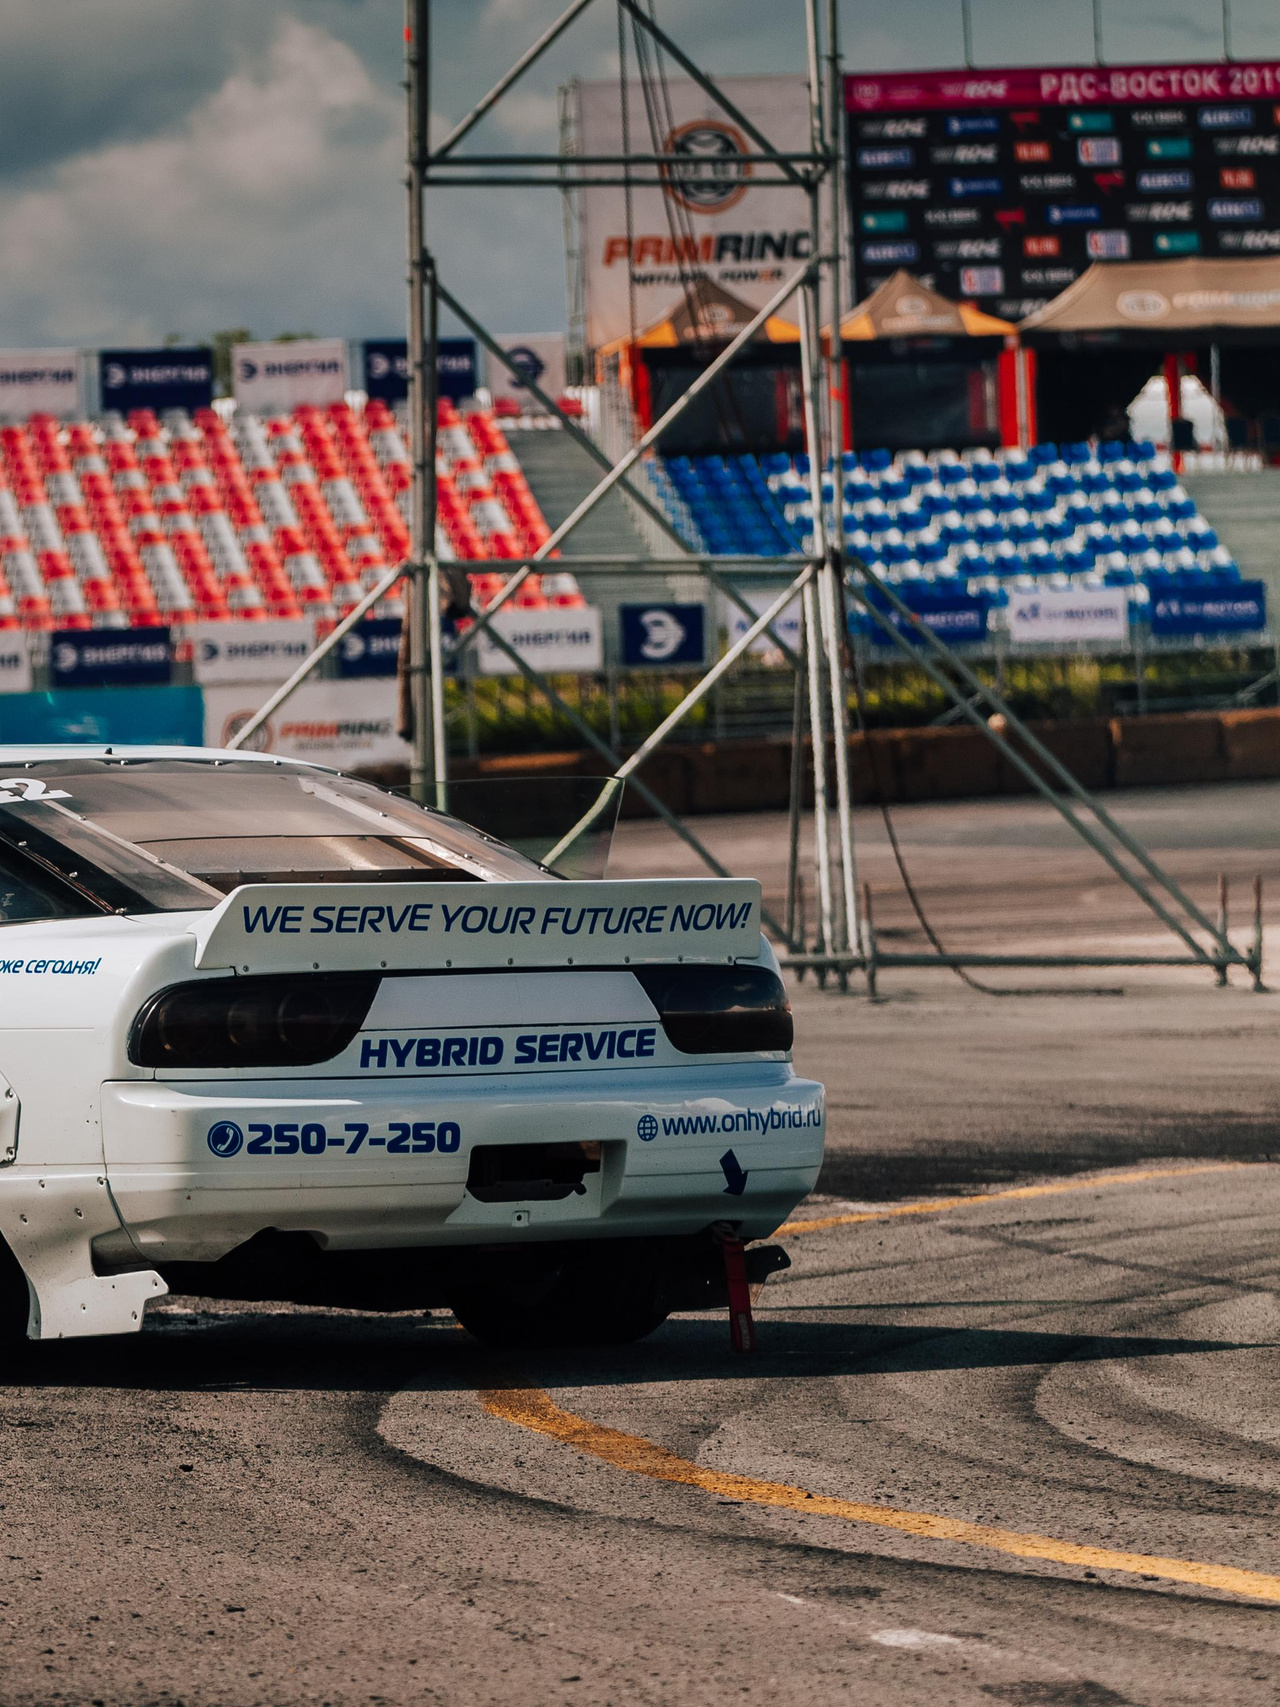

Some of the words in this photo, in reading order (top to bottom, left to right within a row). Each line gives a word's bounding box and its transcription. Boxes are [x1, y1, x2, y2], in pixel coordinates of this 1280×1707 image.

[242, 906, 304, 933] WE
[310, 904, 433, 933] SERVE
[441, 904, 534, 935] YOUR
[540, 905, 664, 935] FUTURE
[669, 902, 752, 933] NOW!
[25, 957, 102, 977] сегодня!
[359, 1036, 504, 1068] HYBRID
[513, 1028, 657, 1064] SERVICE
[246, 1121, 461, 1155] 250-7-250
[662, 1107, 821, 1136] www.onhybrid.ru
